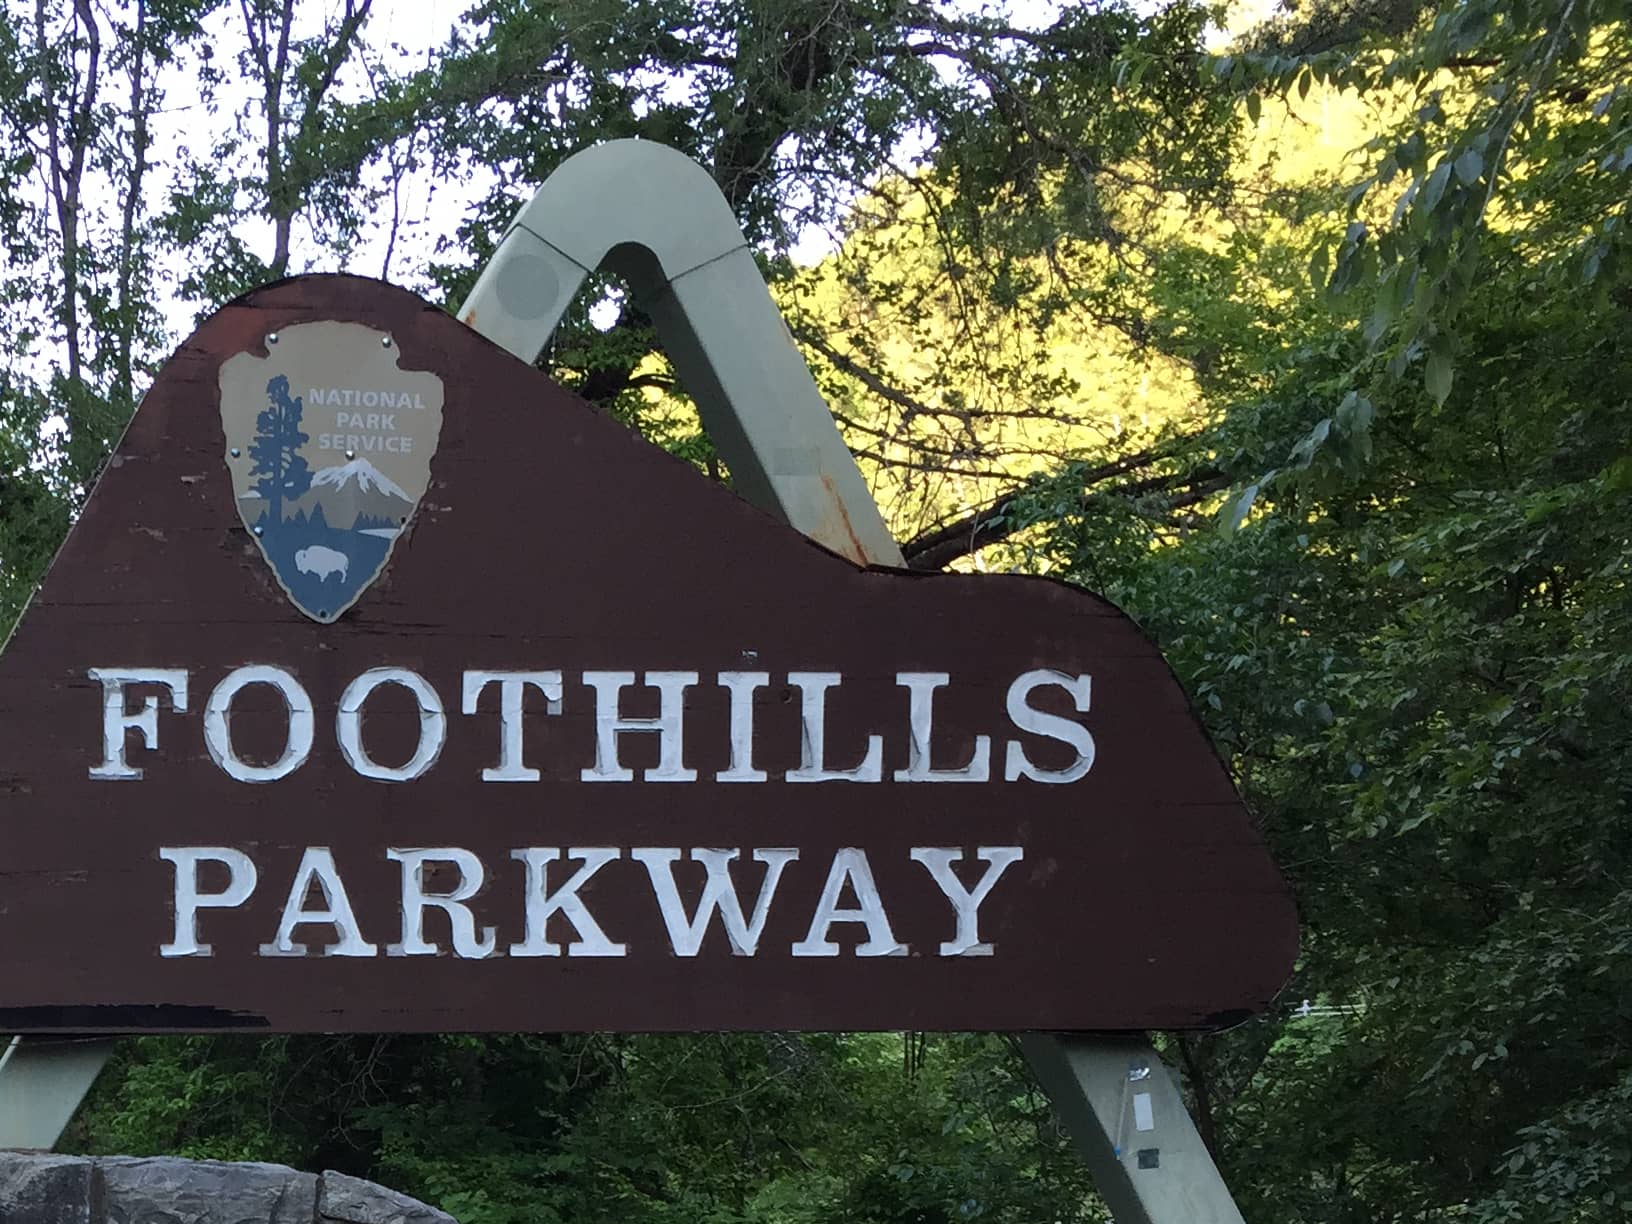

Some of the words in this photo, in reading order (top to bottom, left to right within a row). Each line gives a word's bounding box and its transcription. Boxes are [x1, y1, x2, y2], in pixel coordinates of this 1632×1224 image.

[309, 387, 426, 410] NATIONAL
[336, 411, 396, 431] PARK
[318, 432, 413, 453] SERVICE
[88, 664, 1096, 784] FOOTHILLS
[159, 845, 1024, 960] PARKWAY
